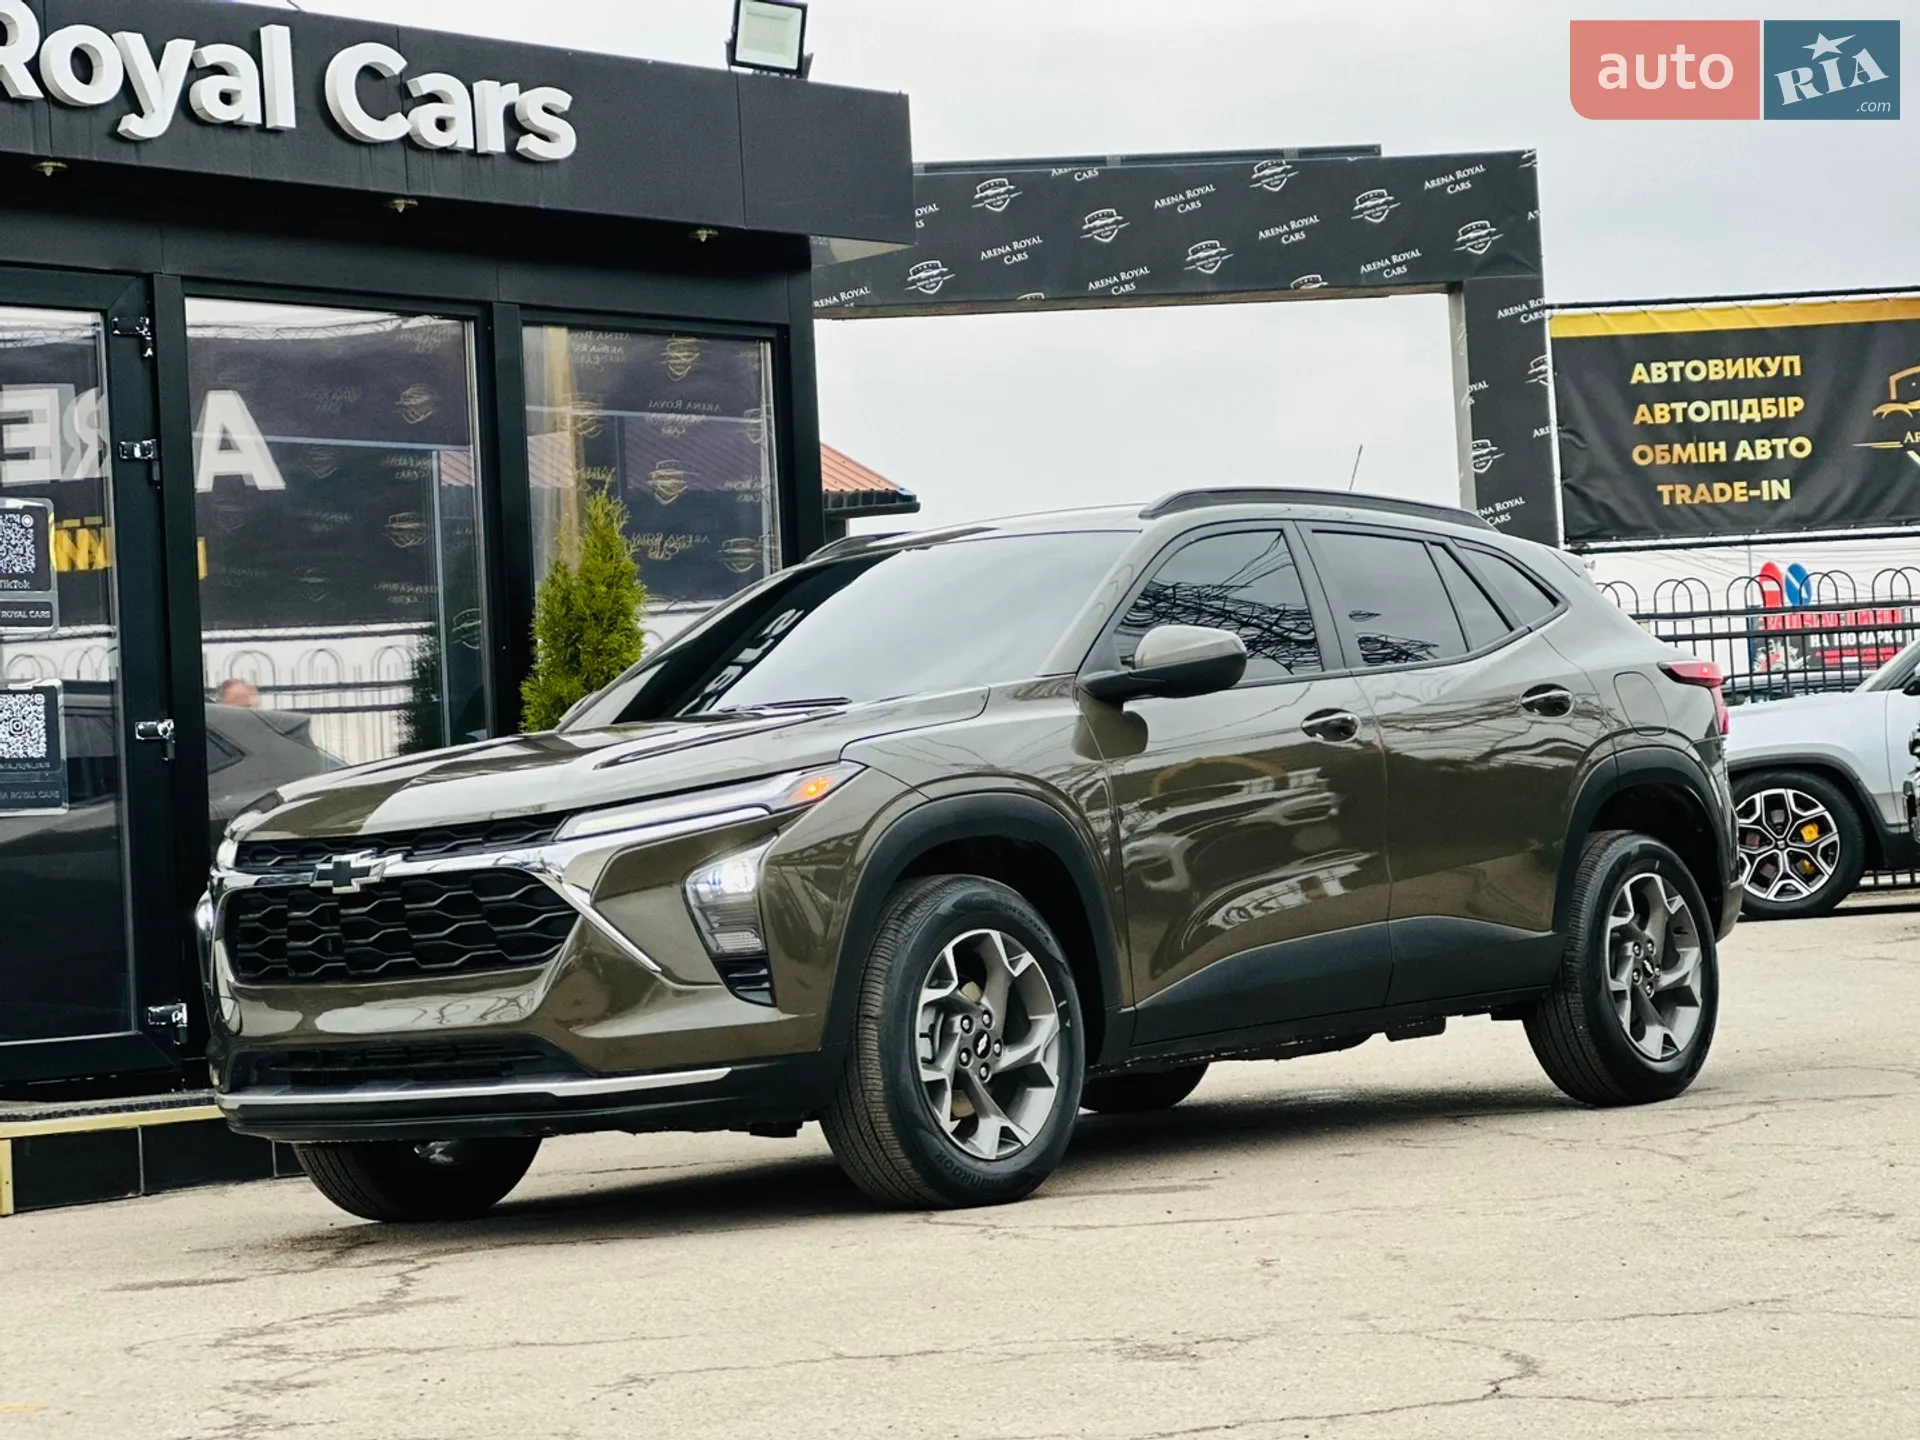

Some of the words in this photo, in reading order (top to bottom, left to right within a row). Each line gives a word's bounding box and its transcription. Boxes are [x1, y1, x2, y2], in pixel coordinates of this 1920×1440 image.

[324, 41, 577, 162] Cars
[915, 203, 940, 217] OYAL
[813, 295, 839, 308] RENA
[1630, 355, 1801, 384] АВТОВИКУП
[1469, 380, 1489, 392] OYAL
[1633, 396, 1805, 425] АВТОПІДБІР
[1632, 440, 1727, 466] ОБМІН
[1734, 436, 1812, 462] АВТО
[1657, 479, 1791, 505] TRADE-IN
